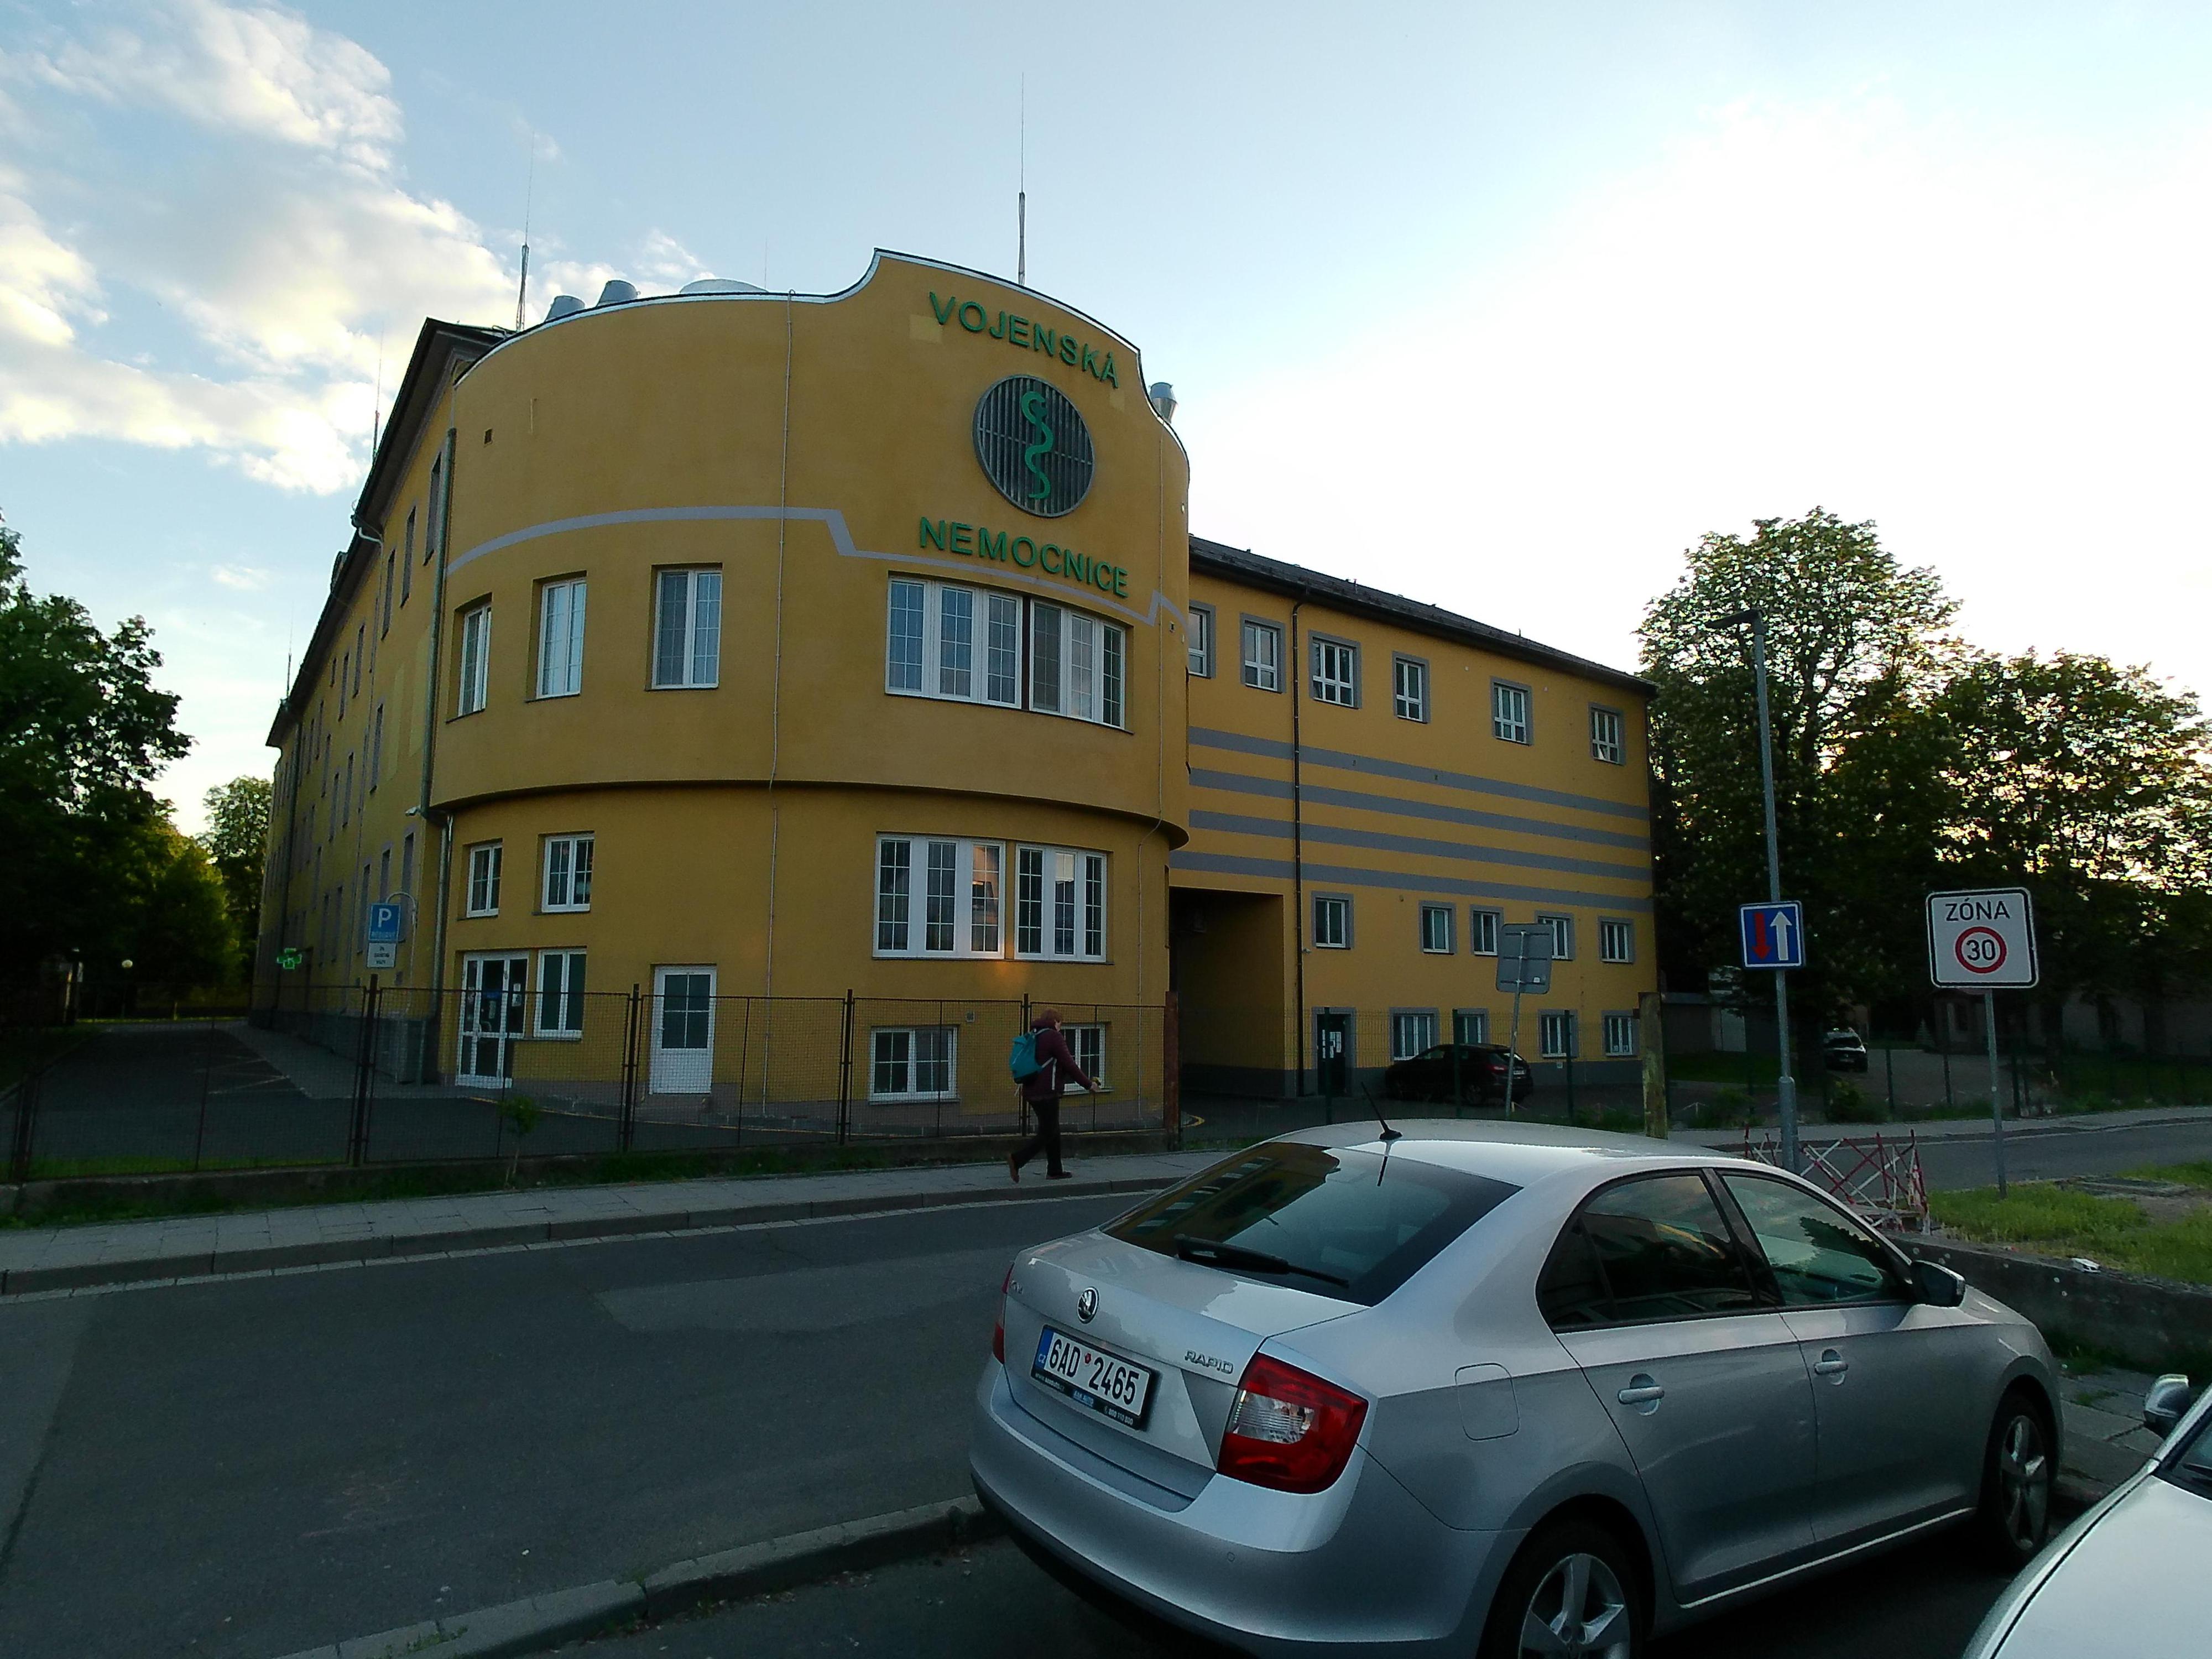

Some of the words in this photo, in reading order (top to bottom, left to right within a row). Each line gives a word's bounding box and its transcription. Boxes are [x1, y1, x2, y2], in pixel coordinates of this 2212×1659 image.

[929, 291, 1120, 389] VOJENSKÁ
[920, 517, 1129, 598] NEMOCNICE
[378, 907, 392, 928] P
[1945, 898, 2011, 922] ZÓNA
[1966, 939, 1996, 961] 30
[1038, 1353, 1046, 1364] CZ
[1049, 1339, 1081, 1378] 6AD
[1088, 1357, 1139, 1405] 2465
[1185, 1350, 1234, 1374] RAPID
